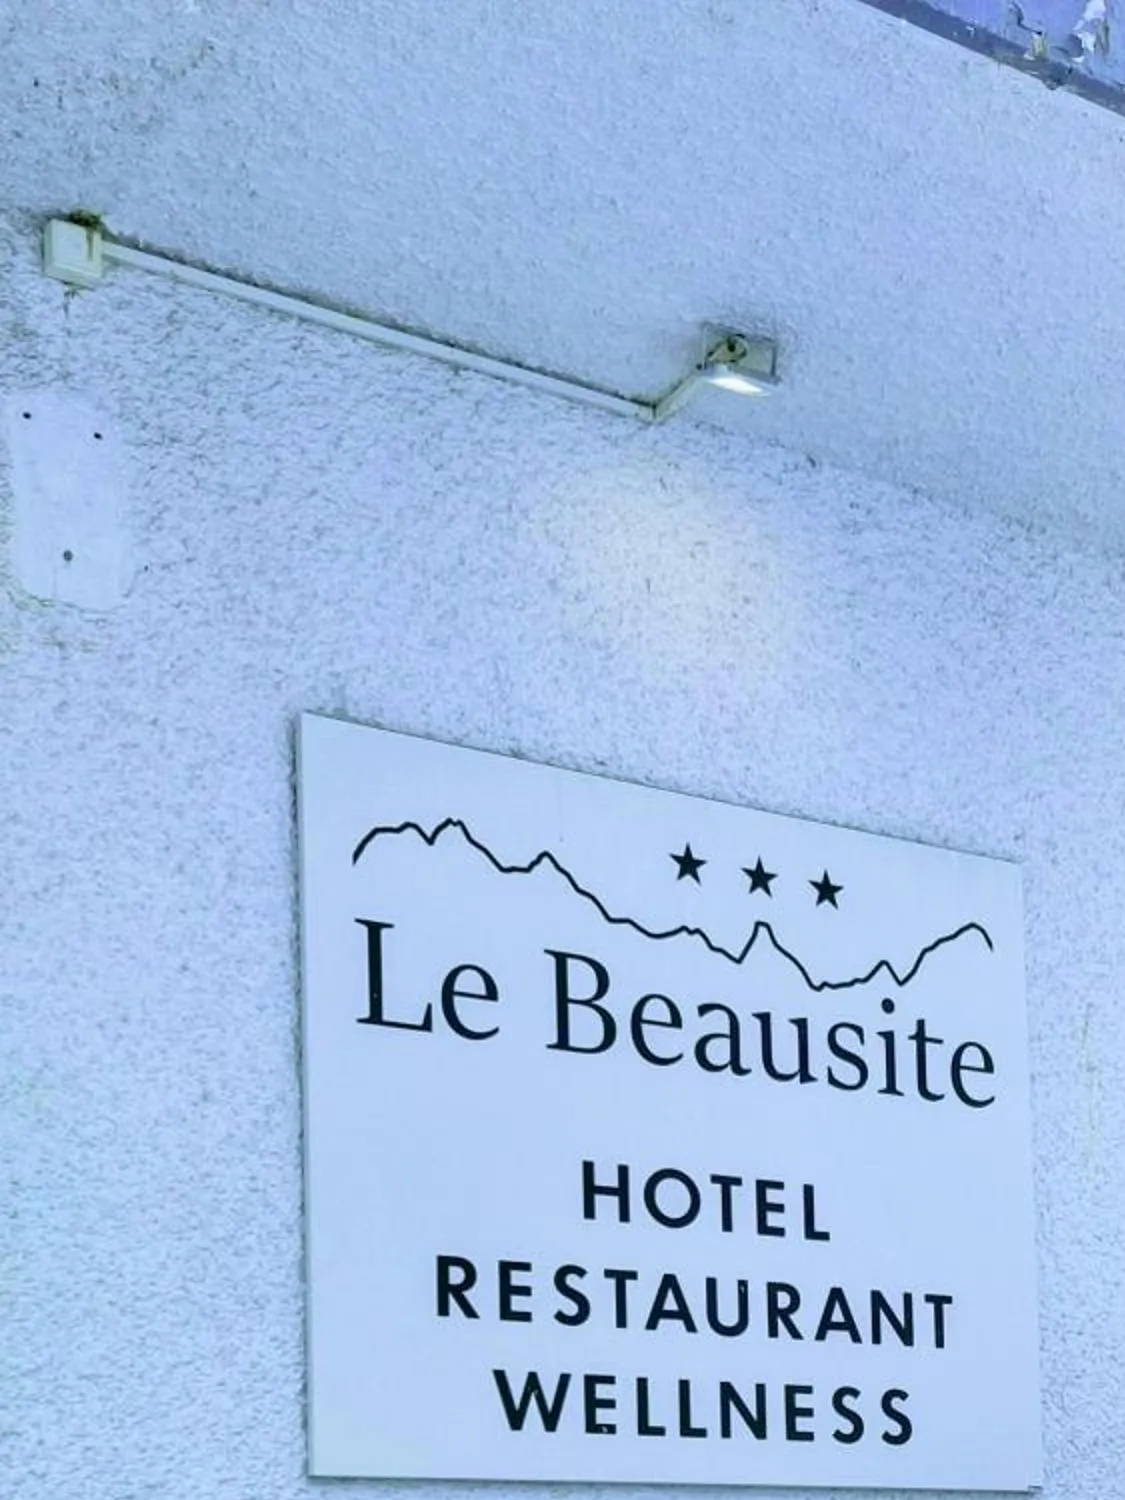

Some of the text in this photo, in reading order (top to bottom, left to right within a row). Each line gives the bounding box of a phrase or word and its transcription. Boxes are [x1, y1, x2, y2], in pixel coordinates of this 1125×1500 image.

[353, 917, 996, 1109] Le Beausite
[581, 1159, 832, 1242] HOTEL
[435, 1254, 954, 1349] RESTAURANT
[492, 1369, 914, 1447] WELLNESS
